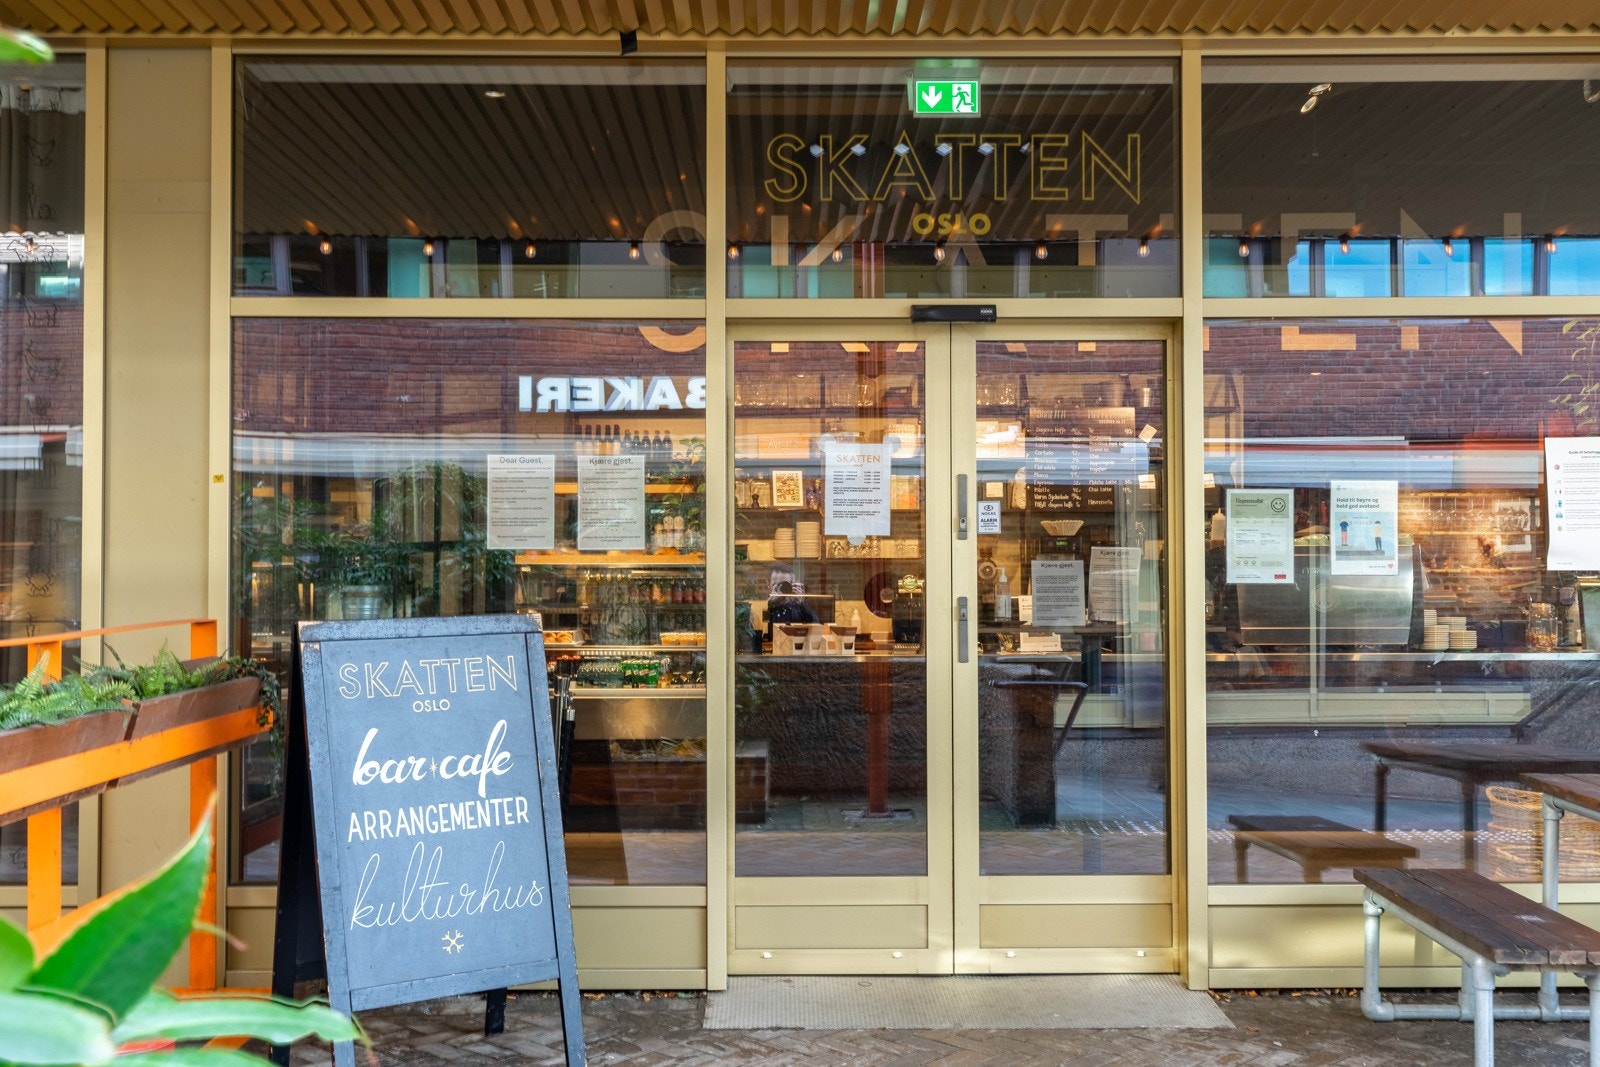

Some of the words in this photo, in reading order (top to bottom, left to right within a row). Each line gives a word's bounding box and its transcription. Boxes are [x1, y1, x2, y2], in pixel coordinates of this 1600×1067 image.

[763, 130, 1141, 204] SKATTEN
[913, 213, 991, 236] OSLO
[499, 456, 517, 464] Dear
[589, 457, 612, 467] Kjære
[836, 454, 881, 463] SKATTEN
[338, 655, 518, 699] SKATTEN
[412, 699, 451, 713] OSLO
[348, 796, 529, 843] ARRANGEMENTER
[350, 841, 545, 931] kulturhus
